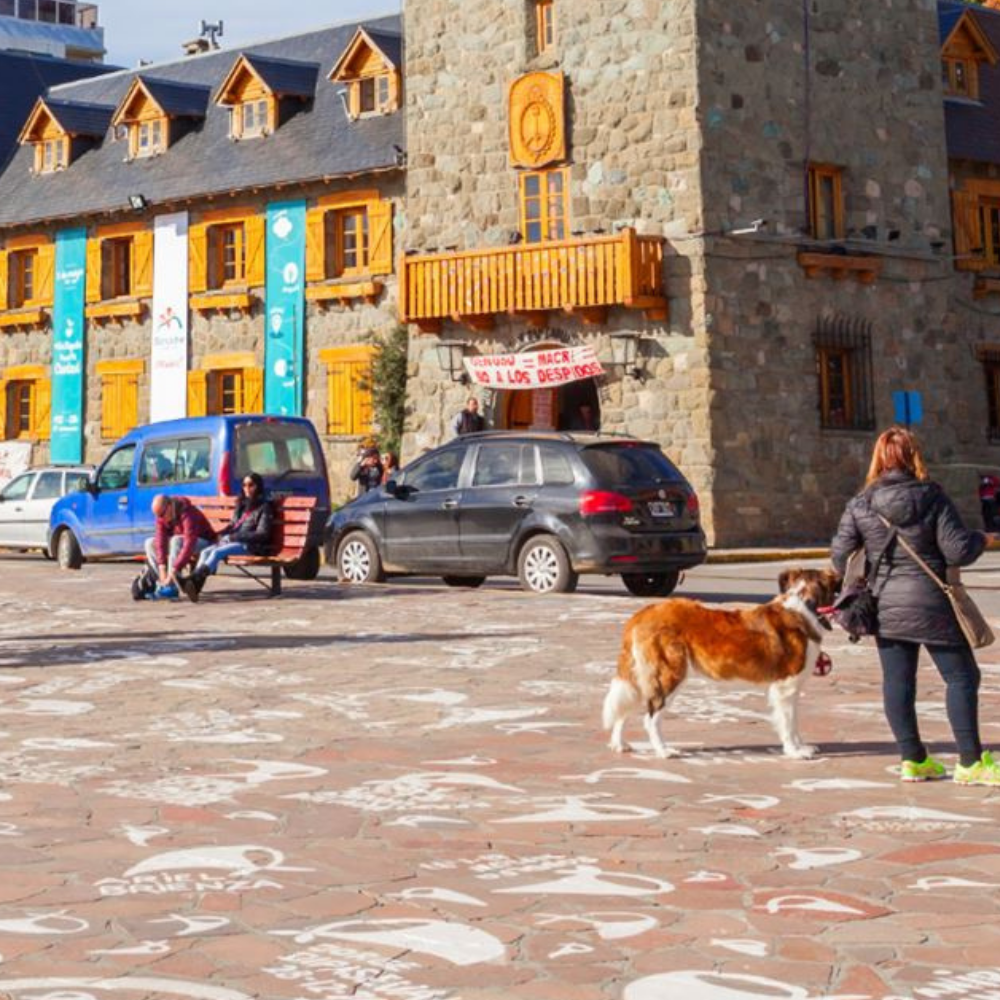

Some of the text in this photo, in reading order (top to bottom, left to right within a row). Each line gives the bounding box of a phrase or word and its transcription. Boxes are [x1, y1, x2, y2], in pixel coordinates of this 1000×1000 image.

[475, 361, 601, 384] NO A LOS DESPIDOS
